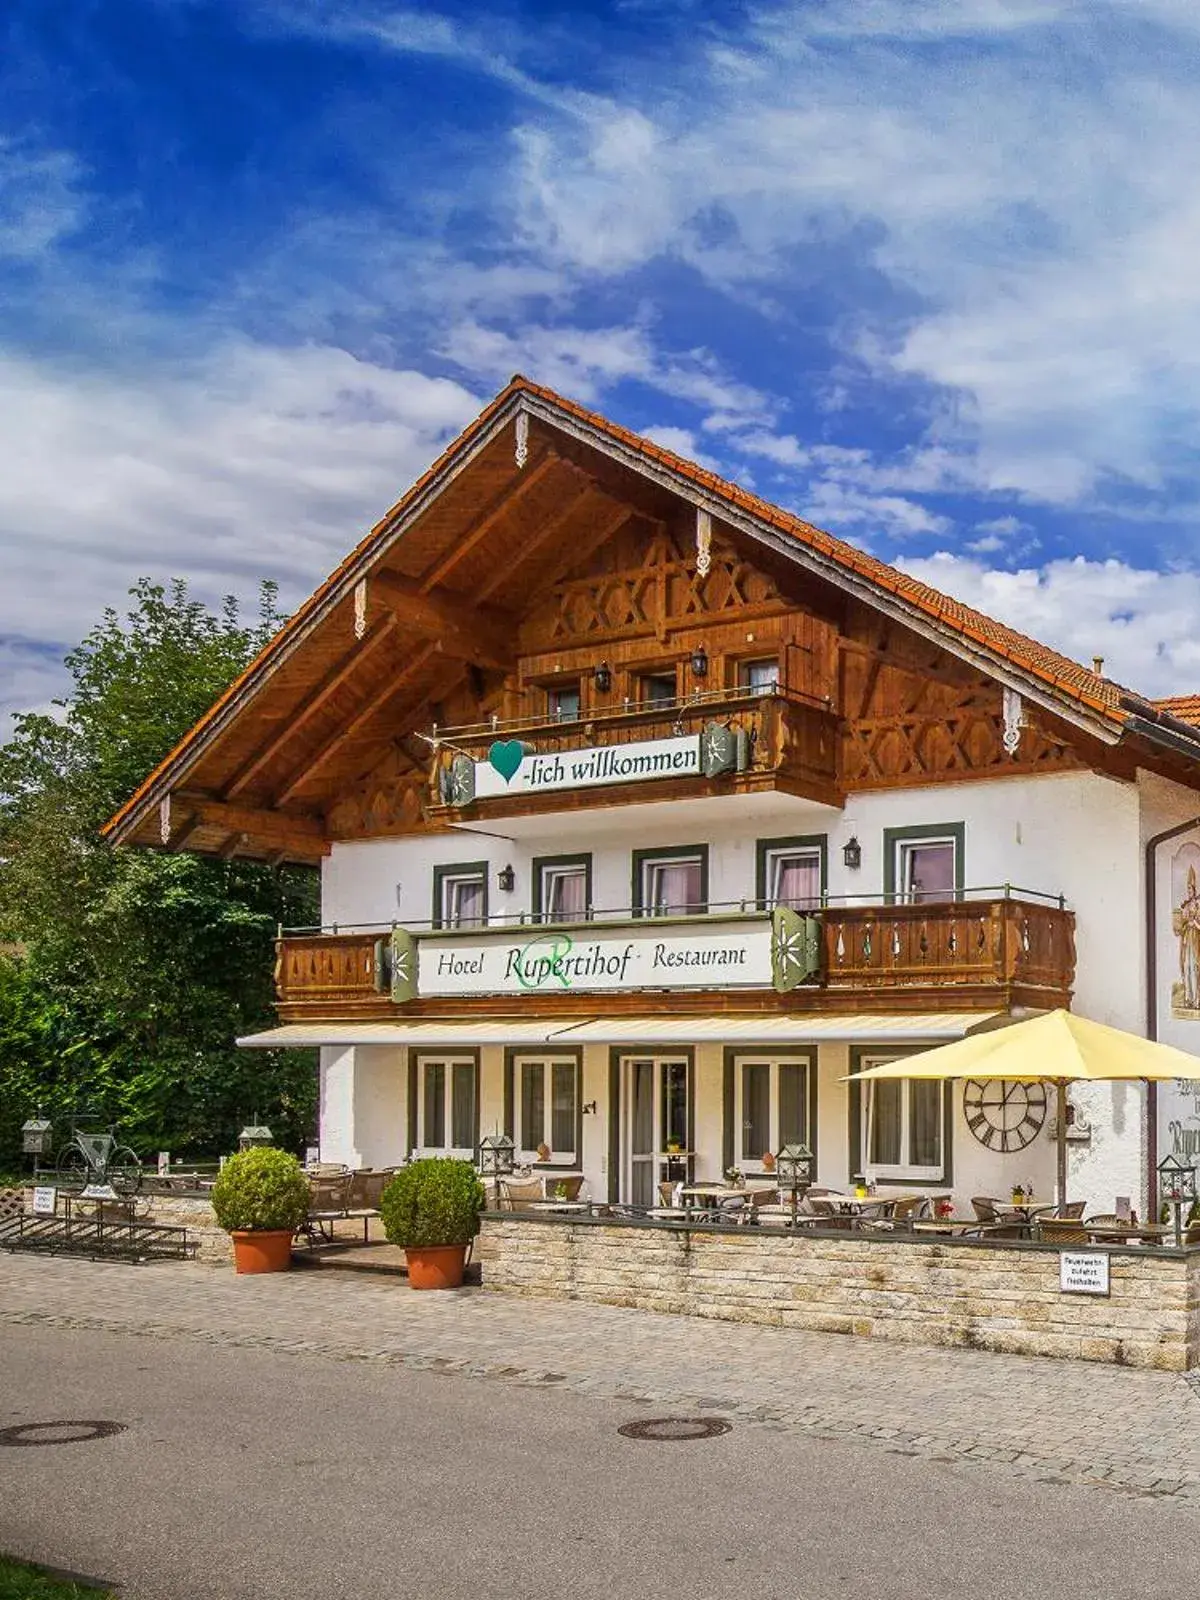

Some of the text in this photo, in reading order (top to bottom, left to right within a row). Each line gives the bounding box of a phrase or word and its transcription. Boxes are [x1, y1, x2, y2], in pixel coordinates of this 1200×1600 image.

[571, 749, 697, 781] willkommen
[437, 943, 747, 985] Hotel Rupertihof Restaurant
